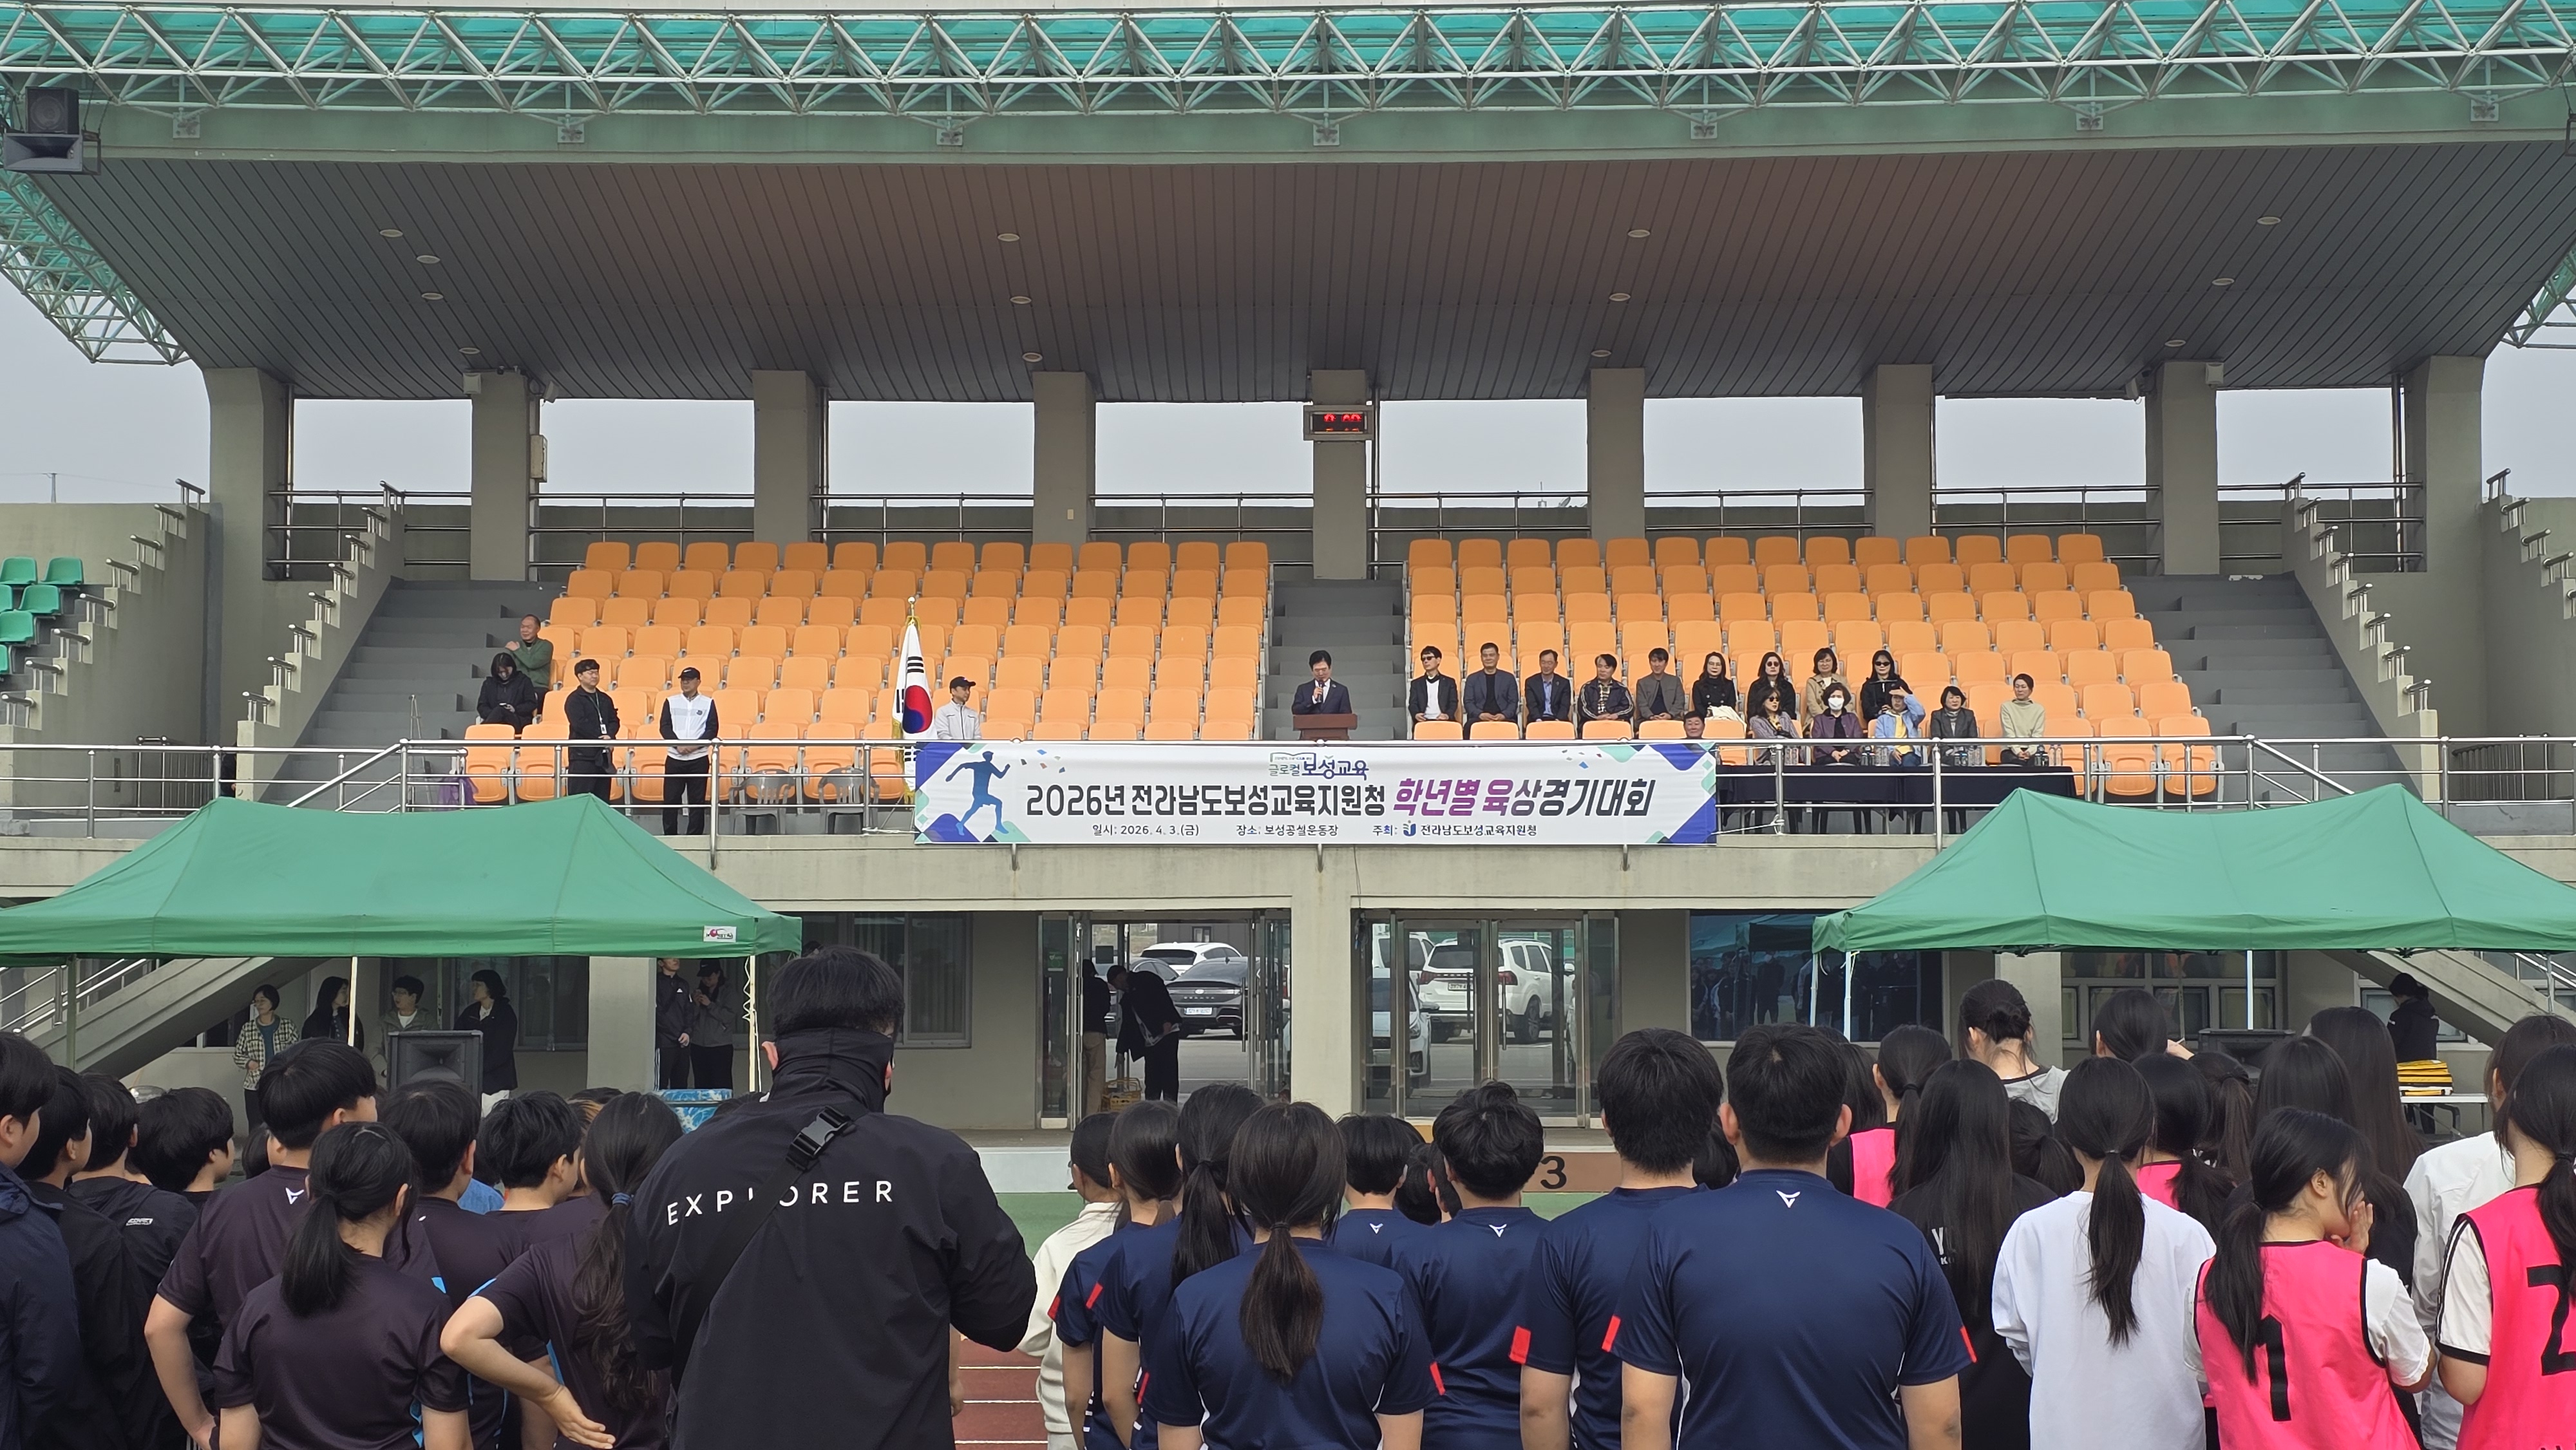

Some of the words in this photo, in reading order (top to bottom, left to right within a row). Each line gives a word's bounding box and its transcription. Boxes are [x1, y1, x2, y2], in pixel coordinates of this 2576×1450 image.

[1269, 764, 1300, 777] 글로컬
[1302, 755, 1369, 781] 보성교육
[1027, 784, 1125, 816] 2026년
[1132, 784, 1385, 816] 전라남도보성교육지원청
[1393, 778, 1481, 816] 학년별
[1482, 778, 1656, 816] 육상경기대회
[1092, 824, 1117, 836] 일시:
[1121, 825, 1153, 835] 2026.
[1236, 824, 1261, 836] 장소:
[1372, 824, 1397, 836] 주최:
[1420, 824, 1537, 836] 전라남도보성교육지원청
[1540, 1155, 1567, 1189] 3
[2255, 1313, 2292, 1422] 1
